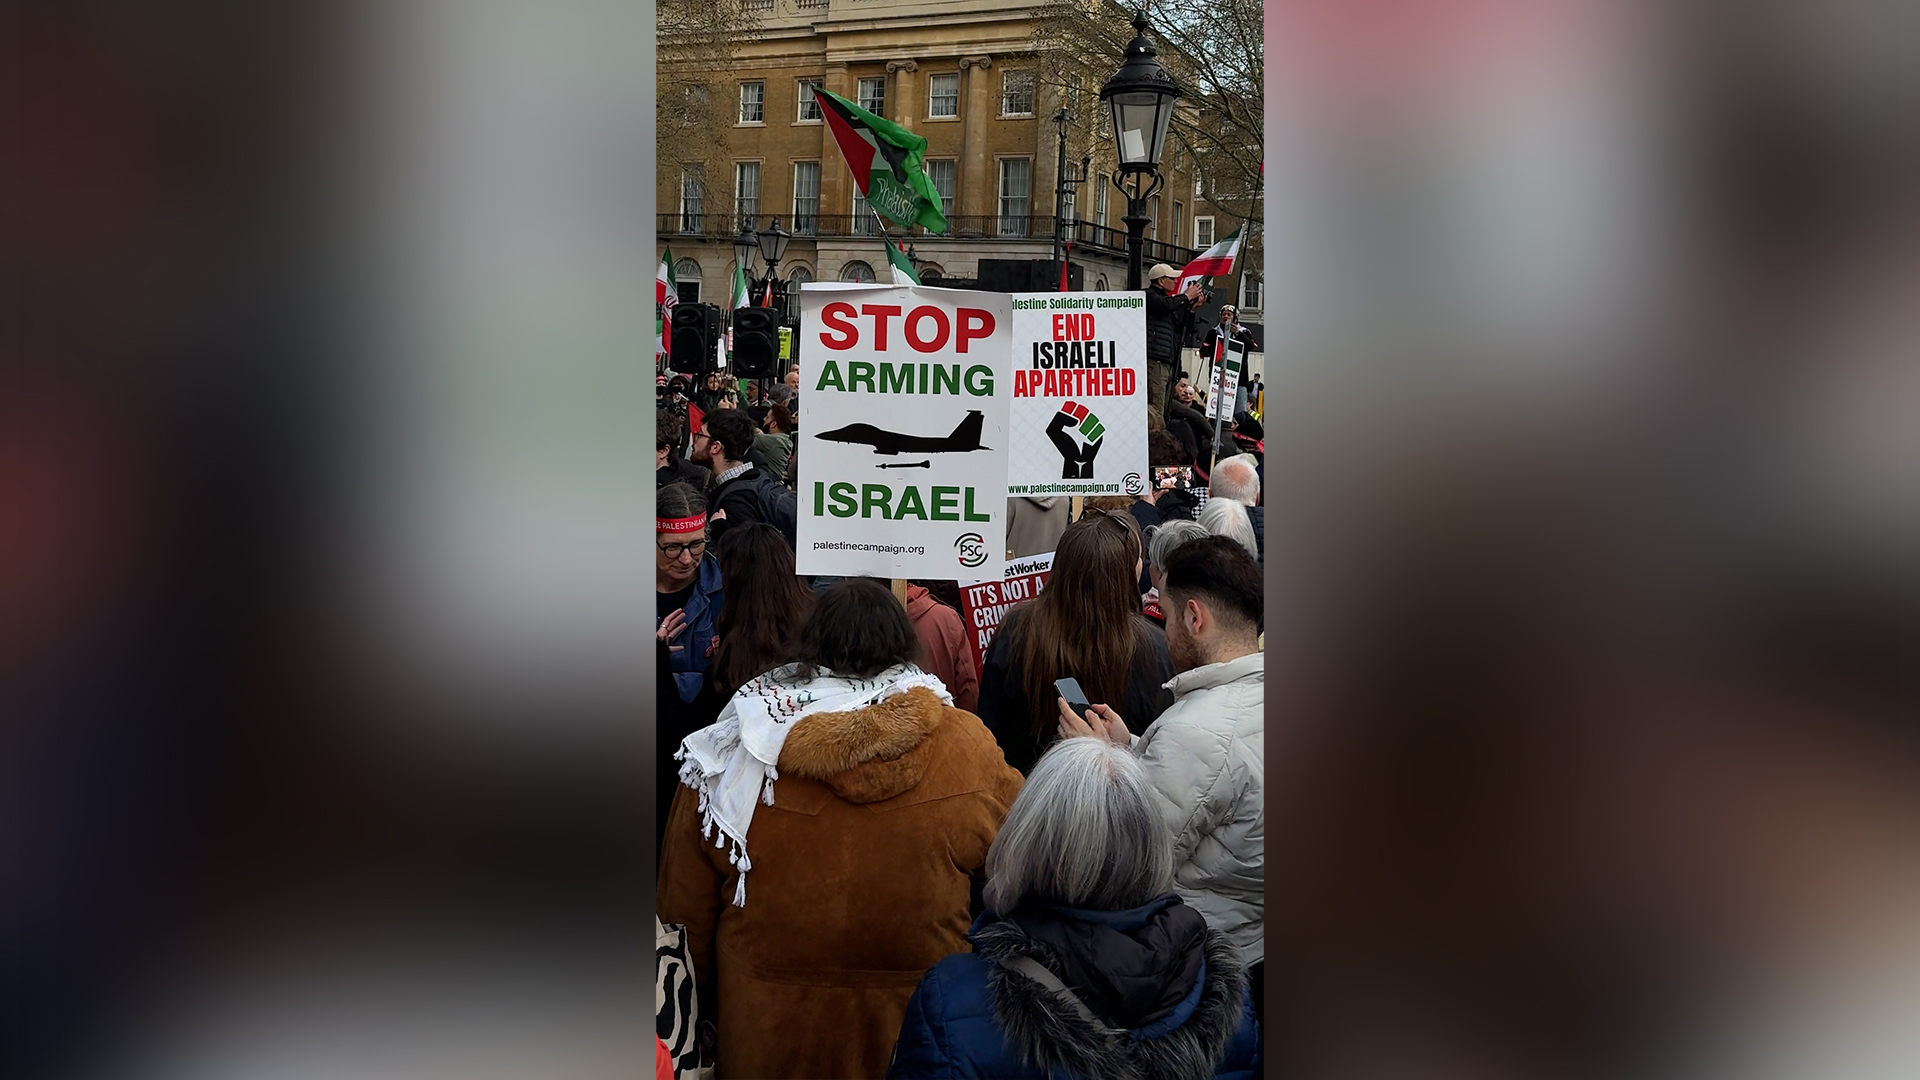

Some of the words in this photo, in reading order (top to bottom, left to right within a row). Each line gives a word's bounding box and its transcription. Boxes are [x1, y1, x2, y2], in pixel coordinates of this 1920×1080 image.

[1012, 297, 1047, 310] lestine
[1049, 297, 1095, 310] Solidarity
[1096, 296, 1144, 310] Campaign
[819, 301, 996, 354] STOP
[1052, 313, 1096, 341] END
[1032, 340, 1116, 370] ISRAELI
[815, 360, 995, 397] ARMING
[1013, 368, 1136, 398] APARTHEID
[813, 481, 991, 523] ISRAEL
[1008, 482, 1119, 495] www.palestinecampaign.org
[813, 541, 925, 556] palestinecampaign.org
[960, 544, 983, 557] PSC
[968, 583, 998, 608] IT'S
[1000, 578, 1030, 602] NOT
[1035, 576, 1045, 596] A
[973, 602, 1018, 628] CRIM
